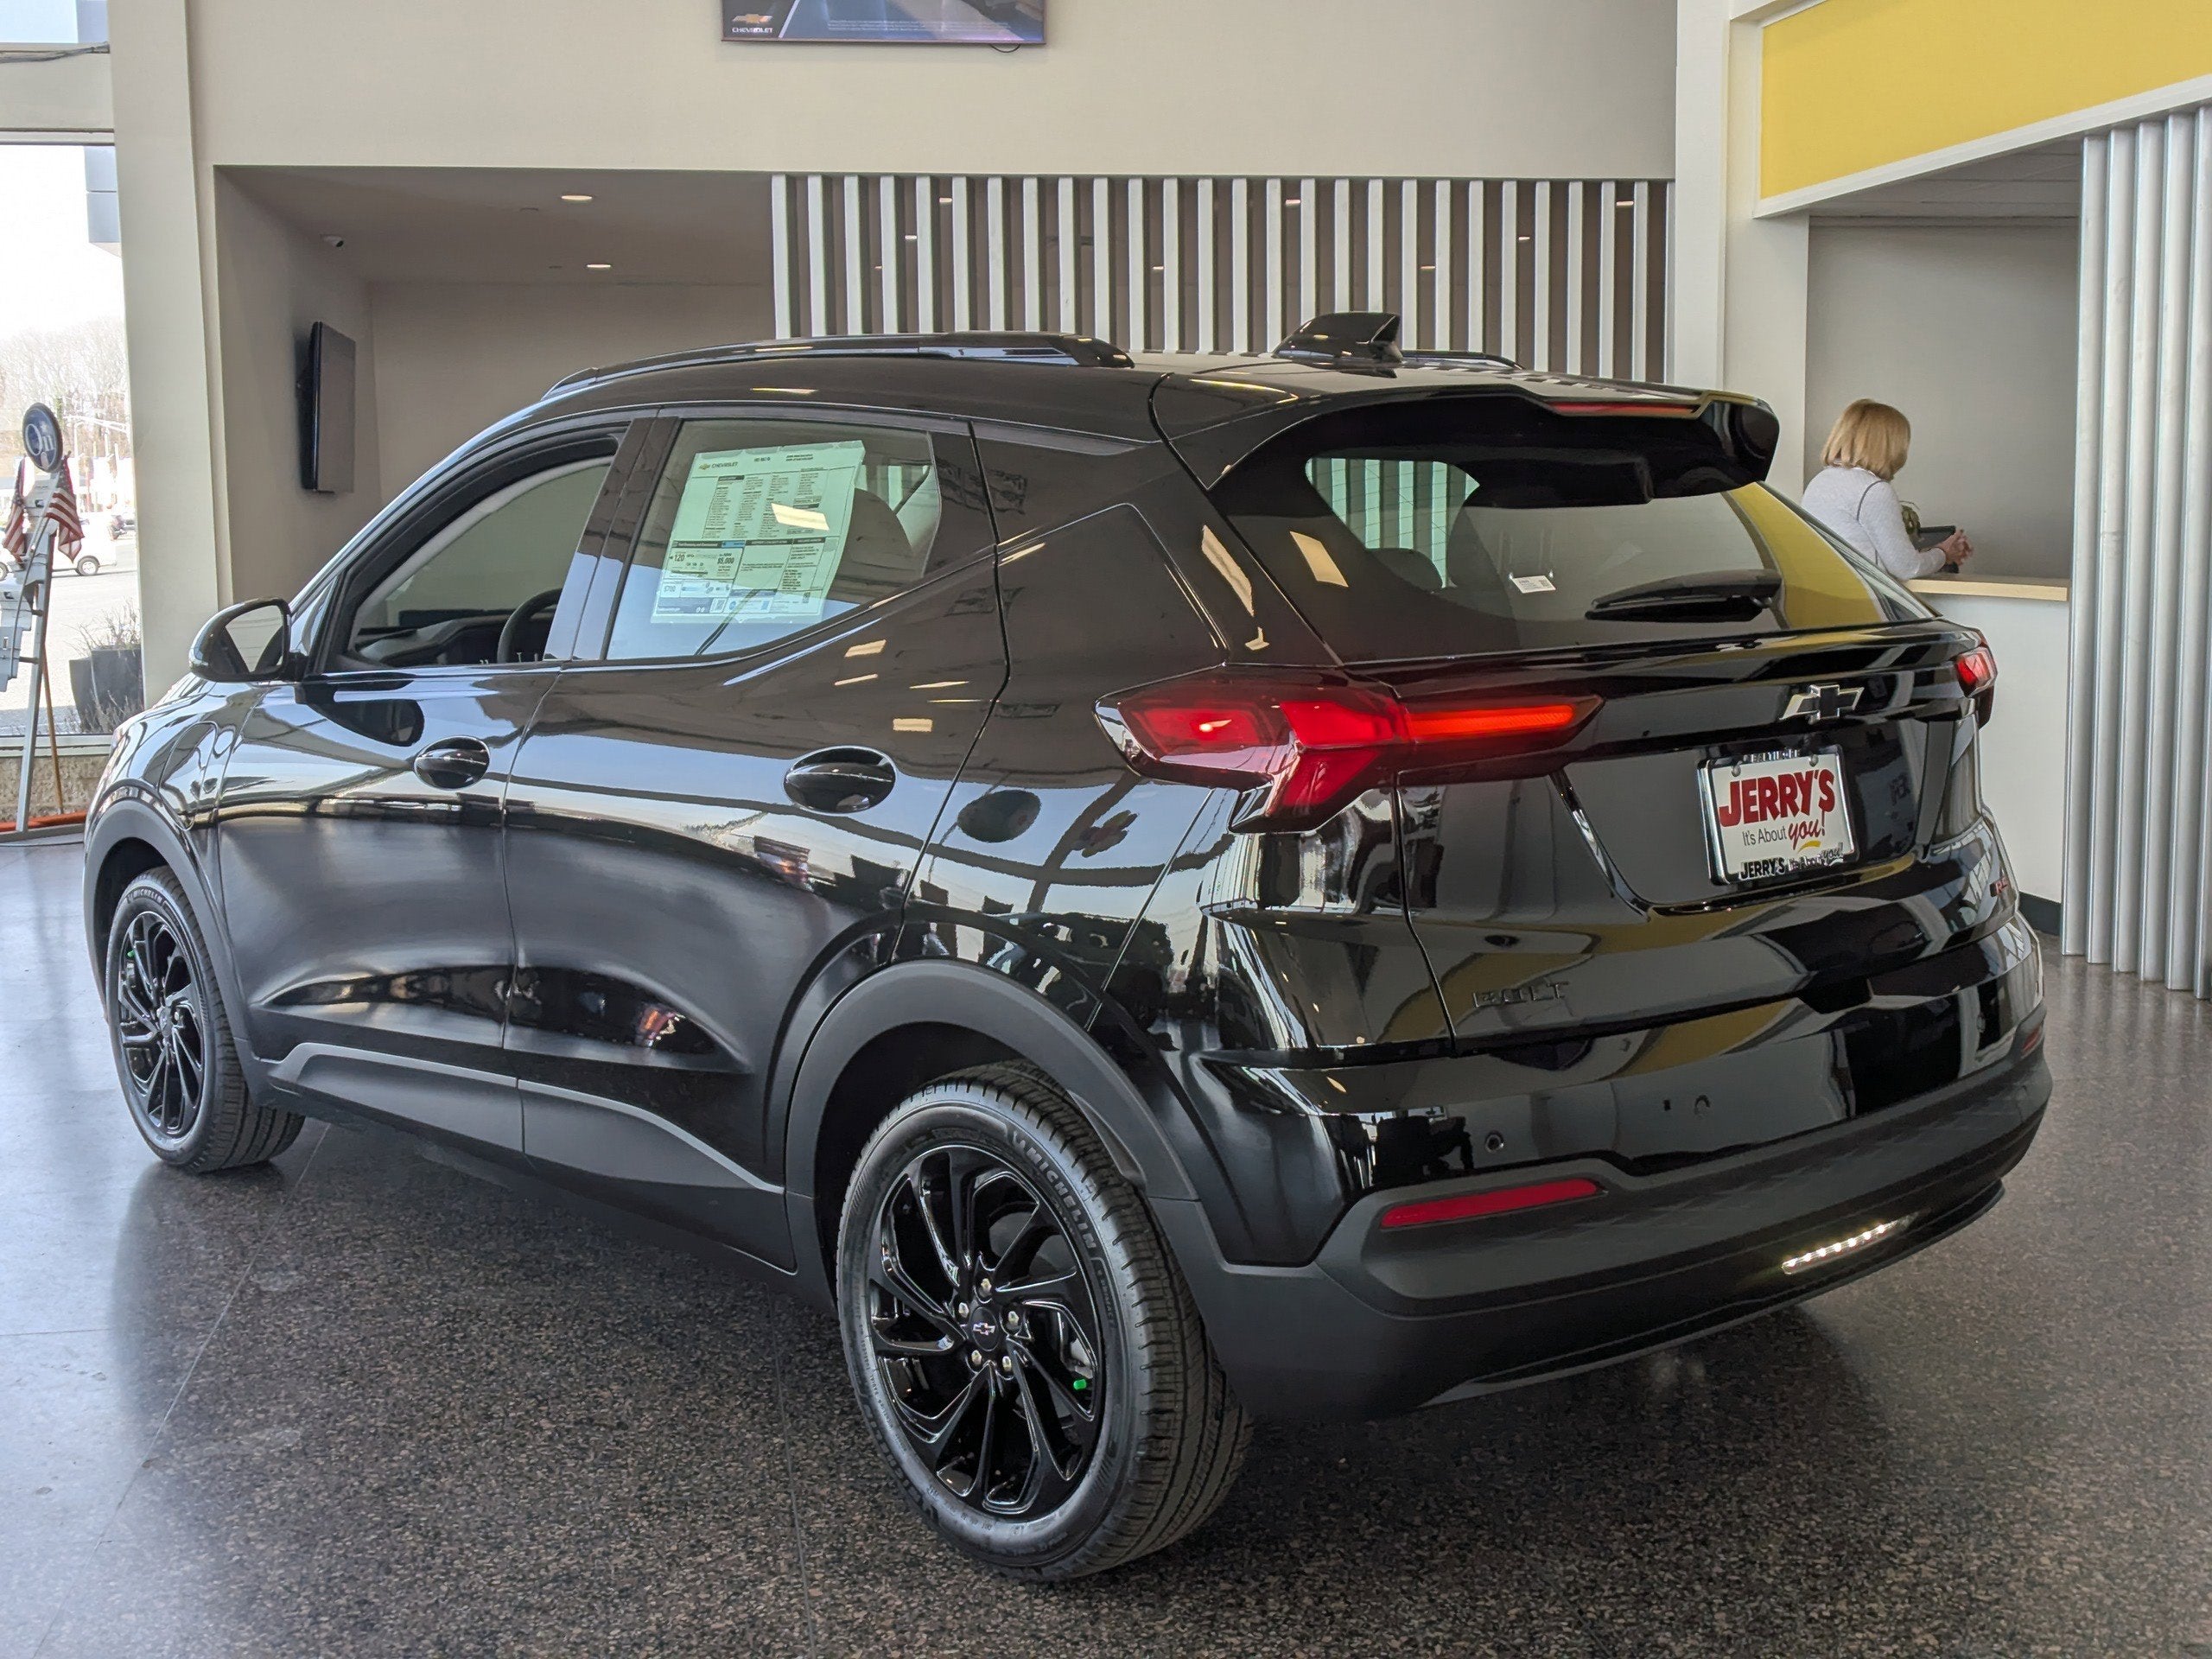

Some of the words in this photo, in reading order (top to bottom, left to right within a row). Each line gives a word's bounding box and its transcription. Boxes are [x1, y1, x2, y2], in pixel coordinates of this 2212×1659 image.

[1718, 768, 1835, 828] JERRY'S
[1742, 829, 1757, 846] It's
[1758, 825, 1787, 845] About
[1789, 810, 1826, 850] you!
[1738, 856, 1786, 880] JERRY'S
[1471, 981, 1570, 1008] BOLT
[1026, 1147, 1097, 1249] MICHELIN
